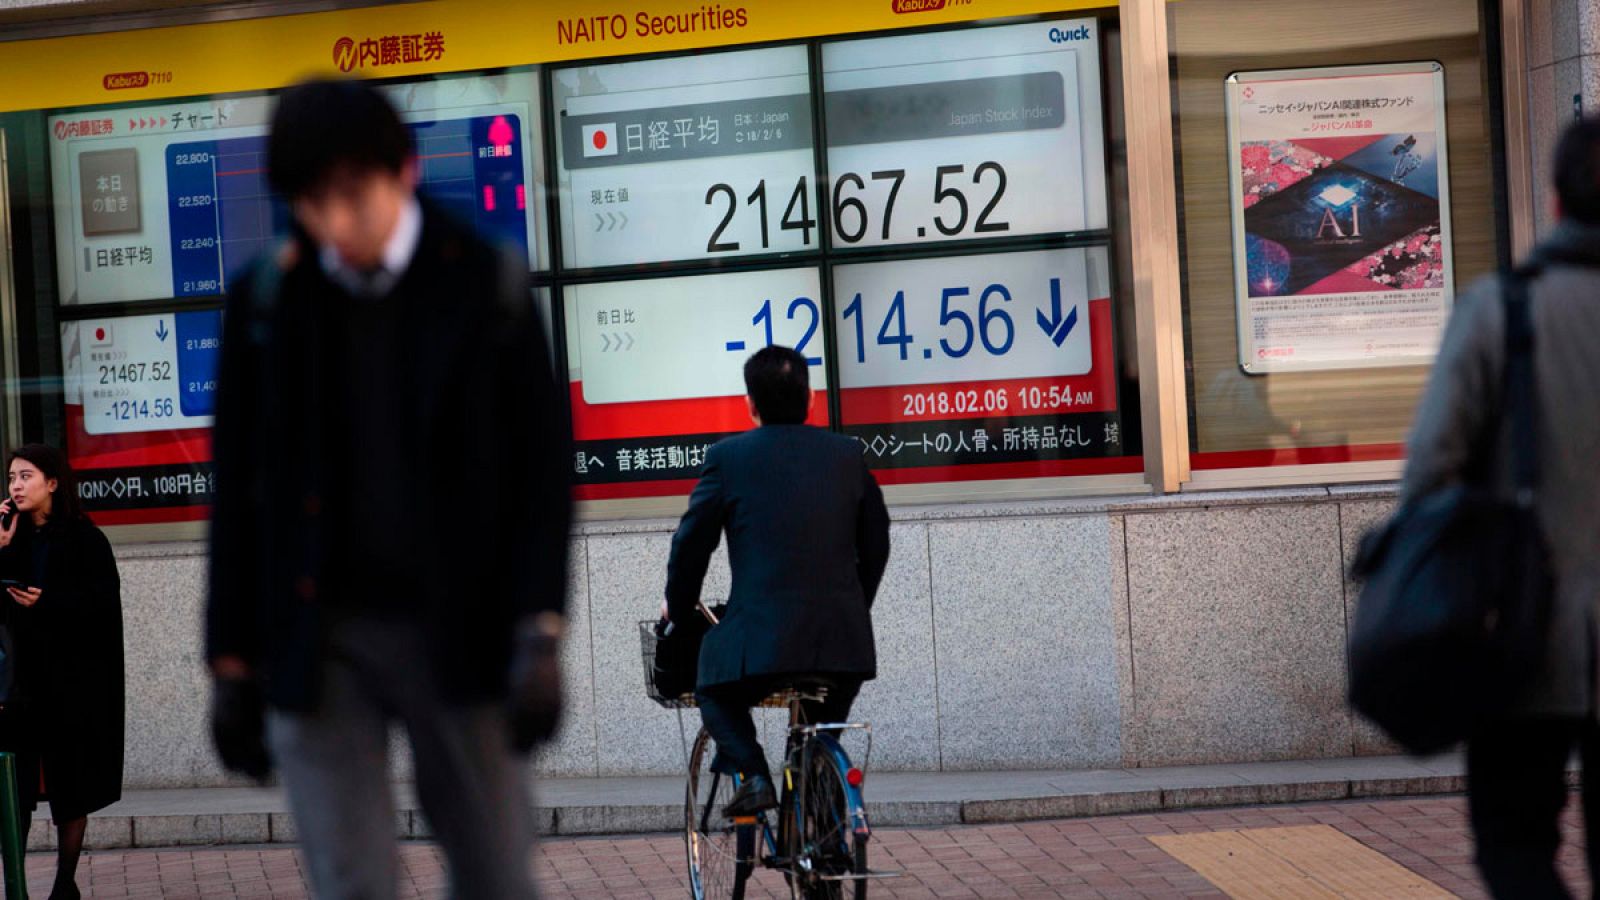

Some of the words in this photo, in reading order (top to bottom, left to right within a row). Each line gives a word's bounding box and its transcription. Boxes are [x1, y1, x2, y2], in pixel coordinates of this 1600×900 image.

[557, 14, 627, 45] NAITO
[635, 6, 748, 38] Securities
[359, 32, 445, 66] 内藤証券
[150, 71, 173, 84] 7110
[171, 108, 228, 130] チャート
[948, 111, 983, 127] Japan
[985, 108, 1018, 123] Stock
[1022, 106, 1053, 119] Index
[625, 115, 720, 152] 日経平均
[96, 175, 122, 192] 本日
[591, 188, 629, 204] 現在値
[705, 161, 1009, 253] 21467.52
[1315, 204, 1361, 238] AI
[96, 246, 153, 268] 日経平均
[597, 308, 635, 325] 前日比
[98, 360, 172, 385] 21467.52
[189, 380, 217, 393] 21,40
[105, 398, 174, 420] -1214.56
[903, 388, 1008, 416] 2018.02.06
[1018, 384, 1072, 409] 10:54
[1075, 391, 1093, 405] AM
